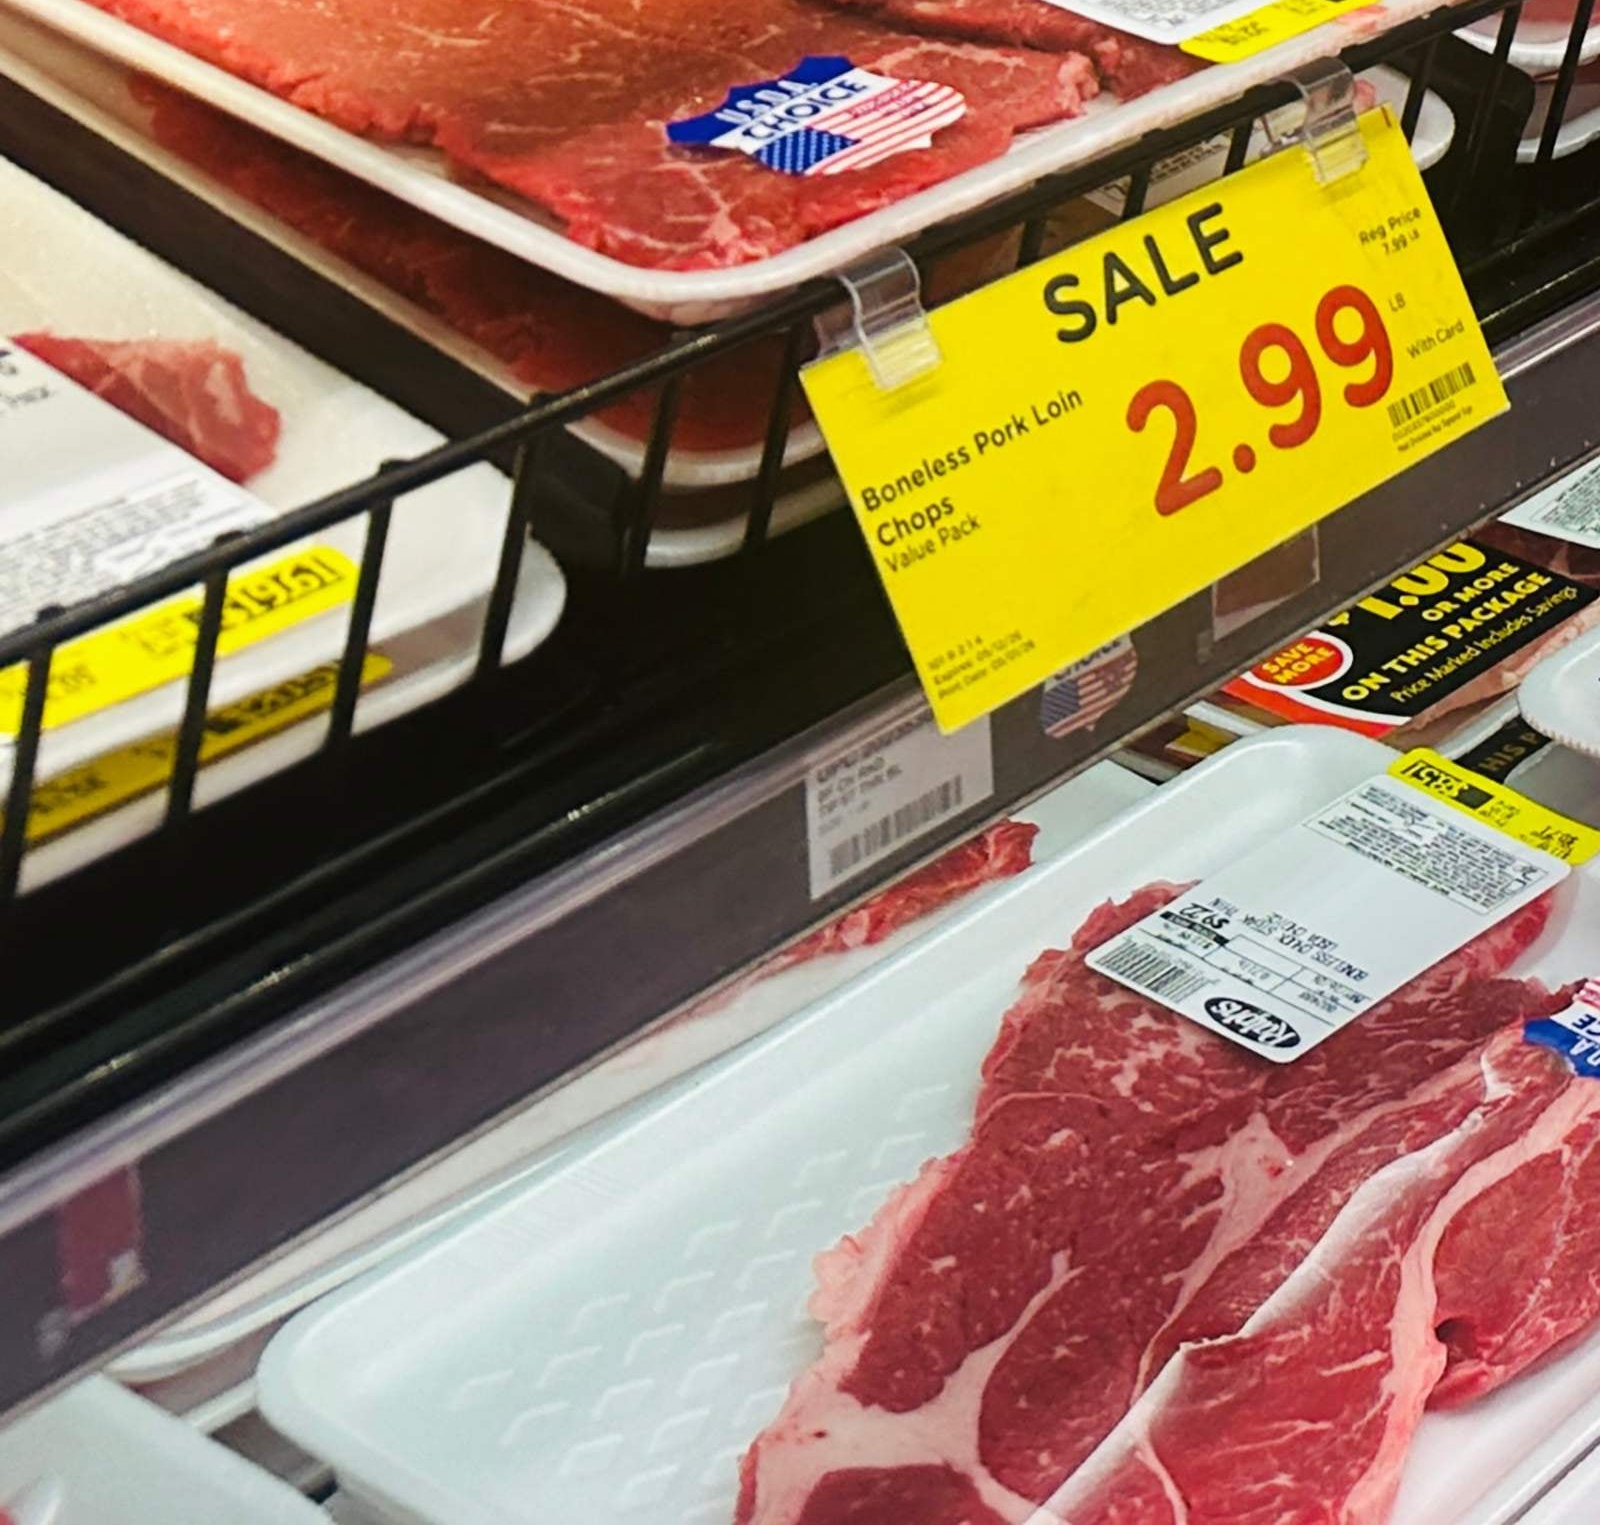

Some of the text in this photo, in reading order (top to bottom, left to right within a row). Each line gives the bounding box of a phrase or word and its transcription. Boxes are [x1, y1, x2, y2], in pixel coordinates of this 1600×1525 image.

[741, 78, 870, 141] CHOICE
[1358, 207, 1422, 247] Reg Price
[1043, 202, 1245, 345] SALE
[1388, 292, 1407, 314] LB
[1406, 319, 1466, 361] With Card
[1125, 283, 1395, 519] 2.99
[860, 385, 1085, 515] Boneless Pork Loin
[877, 492, 957, 552] Chops
[884, 511, 982, 575] Value Pack
[1421, 561, 1521, 622] OR MORE
[1262, 641, 1315, 674] SAVE
[1342, 571, 1553, 701] ON THIS PACKAGE
[1389, 584, 1579, 704] Price Marked Includes Savings
[1273, 648, 1336, 685] MORE
[1476, 742, 1527, 773] HIS
[1209, 999, 1298, 1046] Ralphs
